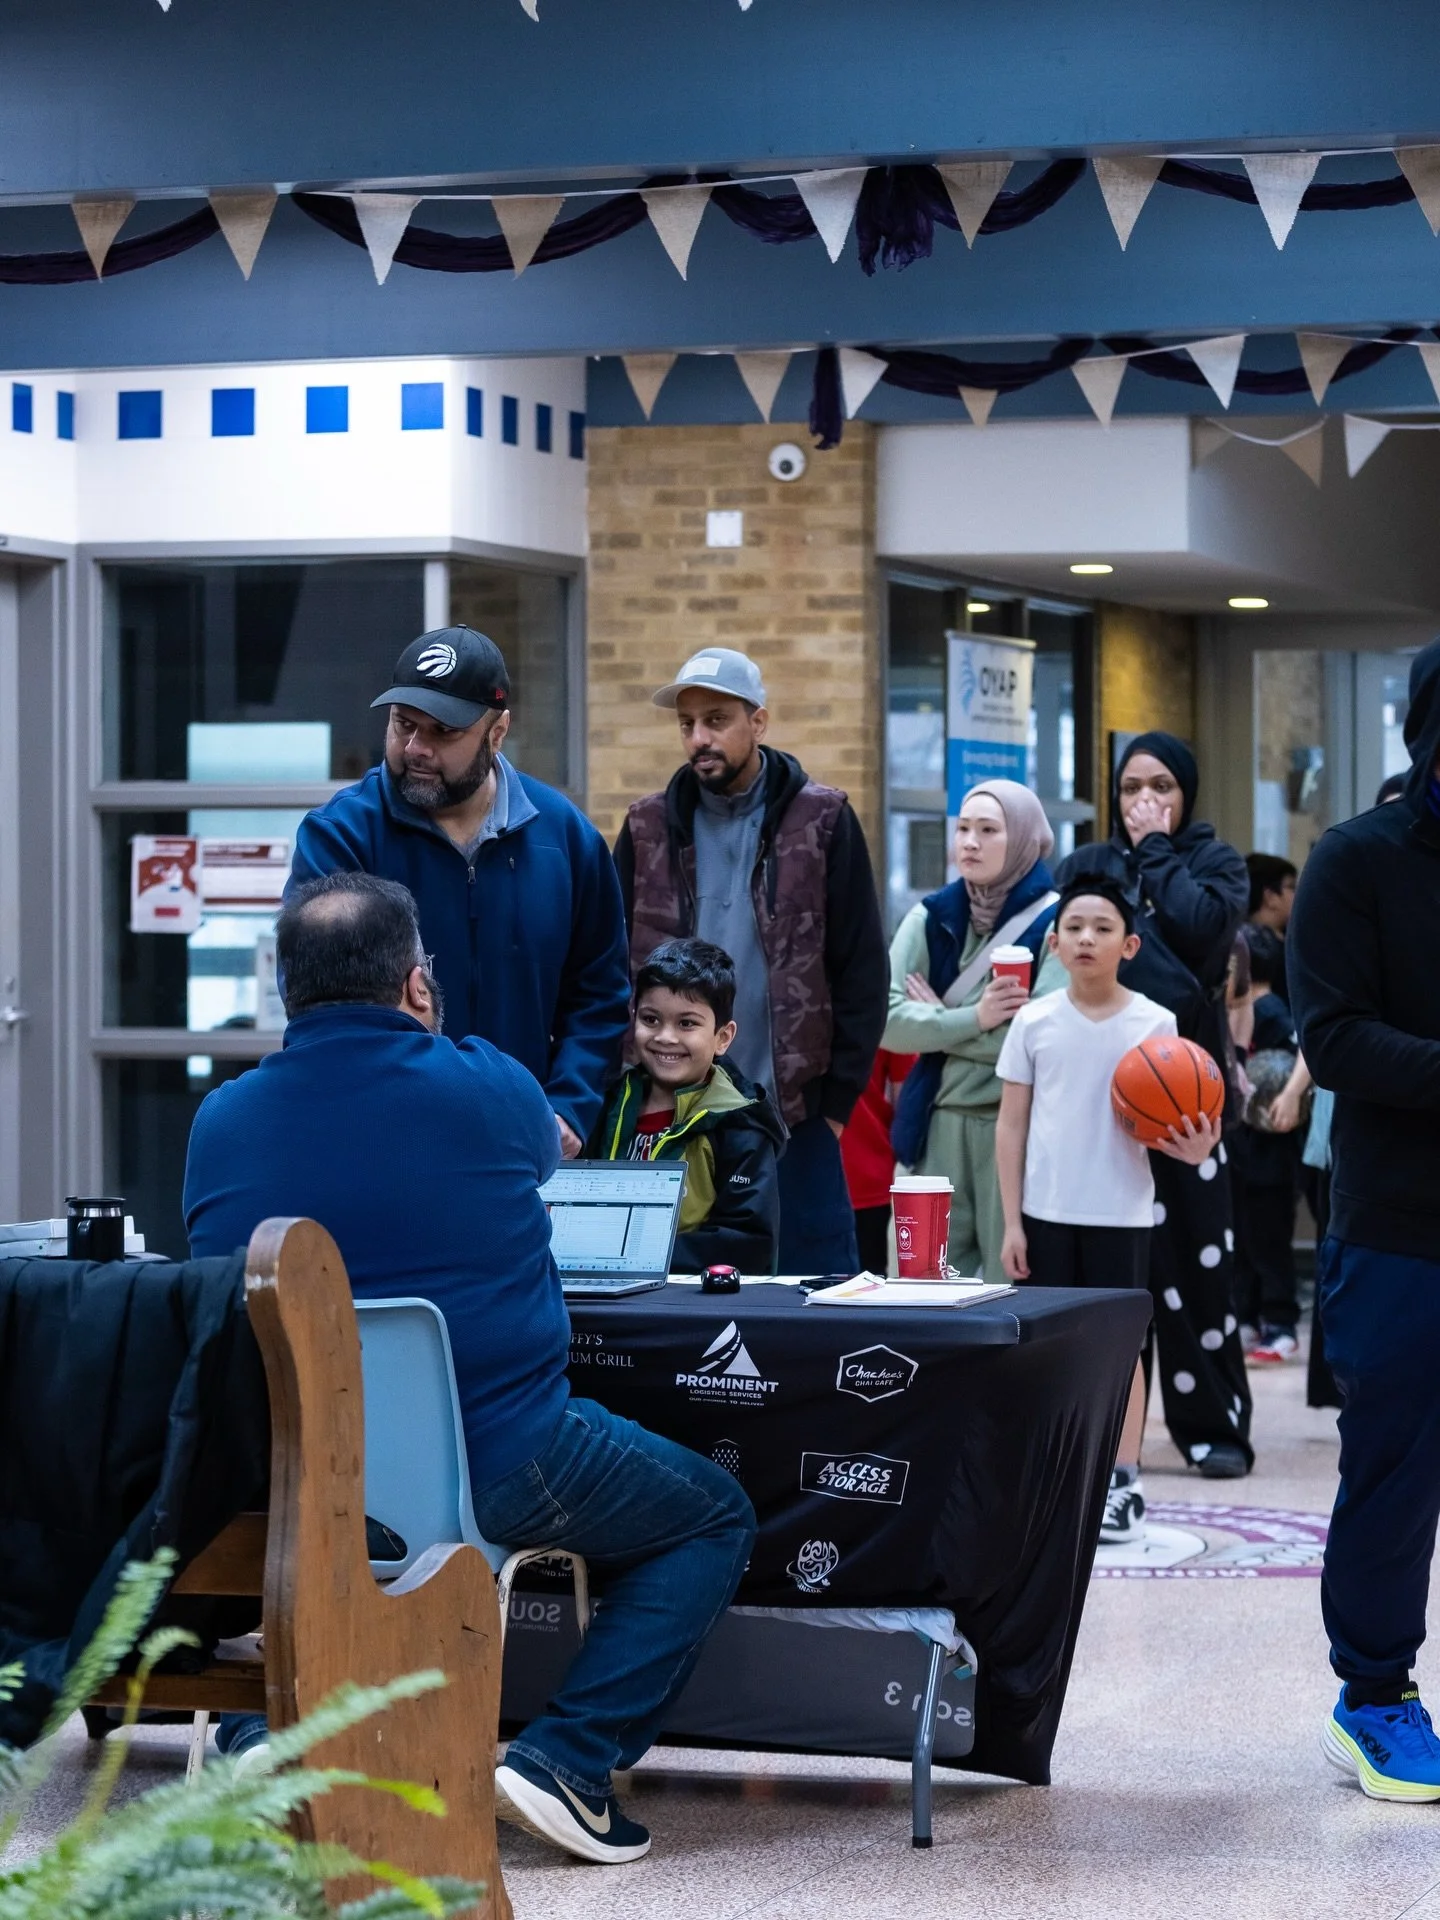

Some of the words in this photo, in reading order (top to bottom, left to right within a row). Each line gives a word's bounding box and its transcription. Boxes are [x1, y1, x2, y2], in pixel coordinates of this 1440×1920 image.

[980, 666, 1018, 699] OYAP
[596, 1352, 635, 1368] GRILL
[675, 1373, 780, 1393] PROMINENT
[689, 1389, 727, 1397] LOGISTICS
[728, 1391, 762, 1399] SERVICES
[818, 1461, 893, 1483] ACCESS
[816, 1473, 890, 1495] STORAGE
[1355, 1727, 1392, 1767] HOKA
